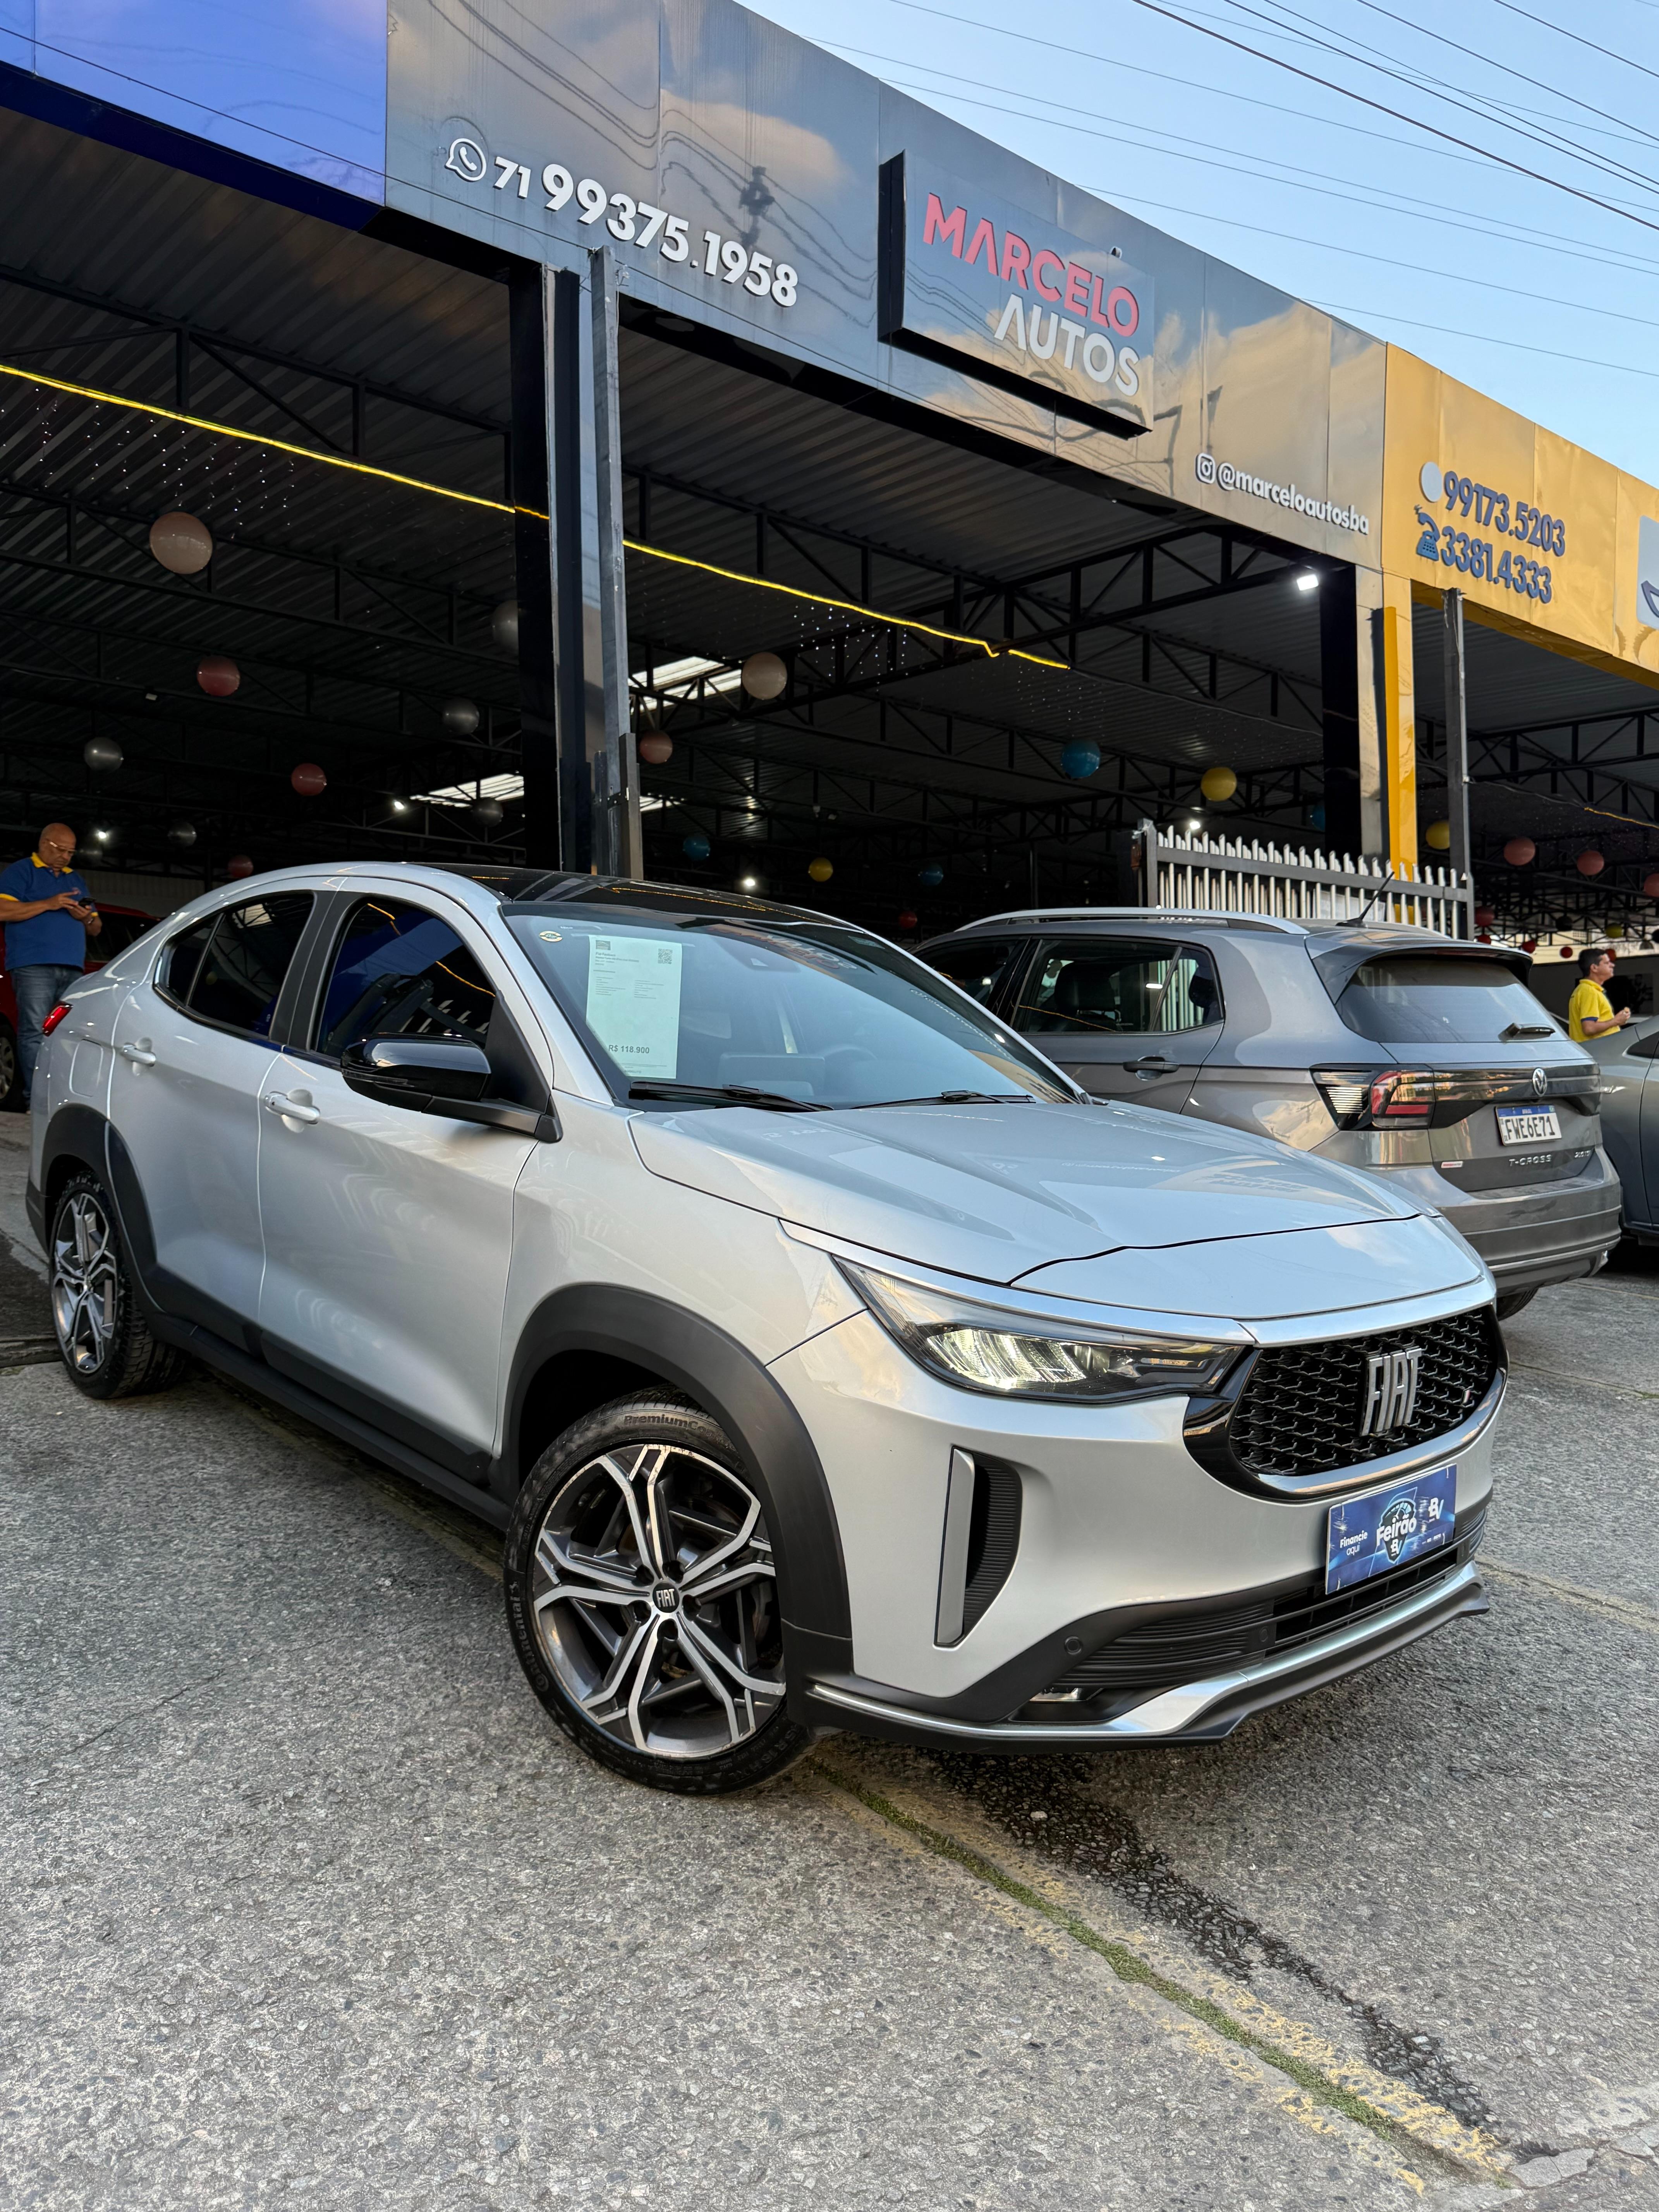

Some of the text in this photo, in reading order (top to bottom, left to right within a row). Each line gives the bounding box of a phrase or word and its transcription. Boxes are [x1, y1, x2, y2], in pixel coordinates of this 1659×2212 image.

[494, 156, 799, 307] 71 99375.1958
[923, 192, 1139, 337] MARCELO
[994, 294, 1140, 396] AUTOS
[1217, 462, 1369, 535] @marceloautosba
[1444, 471, 1565, 556] 99173.5203
[1441, 526, 1552, 603] 3381.4333
[621, 1046, 650, 1054] 118.900
[1505, 1116, 1555, 1140] FWE6E71
[1509, 1154, 1552, 1166] T-CROSS
[1362, 1348, 1422, 1436] FIAT
[1340, 1530, 1368, 1548] Financie
[1346, 1542, 1360, 1555] aqui
[1377, 1513, 1417, 1547] Feirão
[656, 1589, 676, 1607] FIAT
[510, 1596, 549, 1692] Continental
